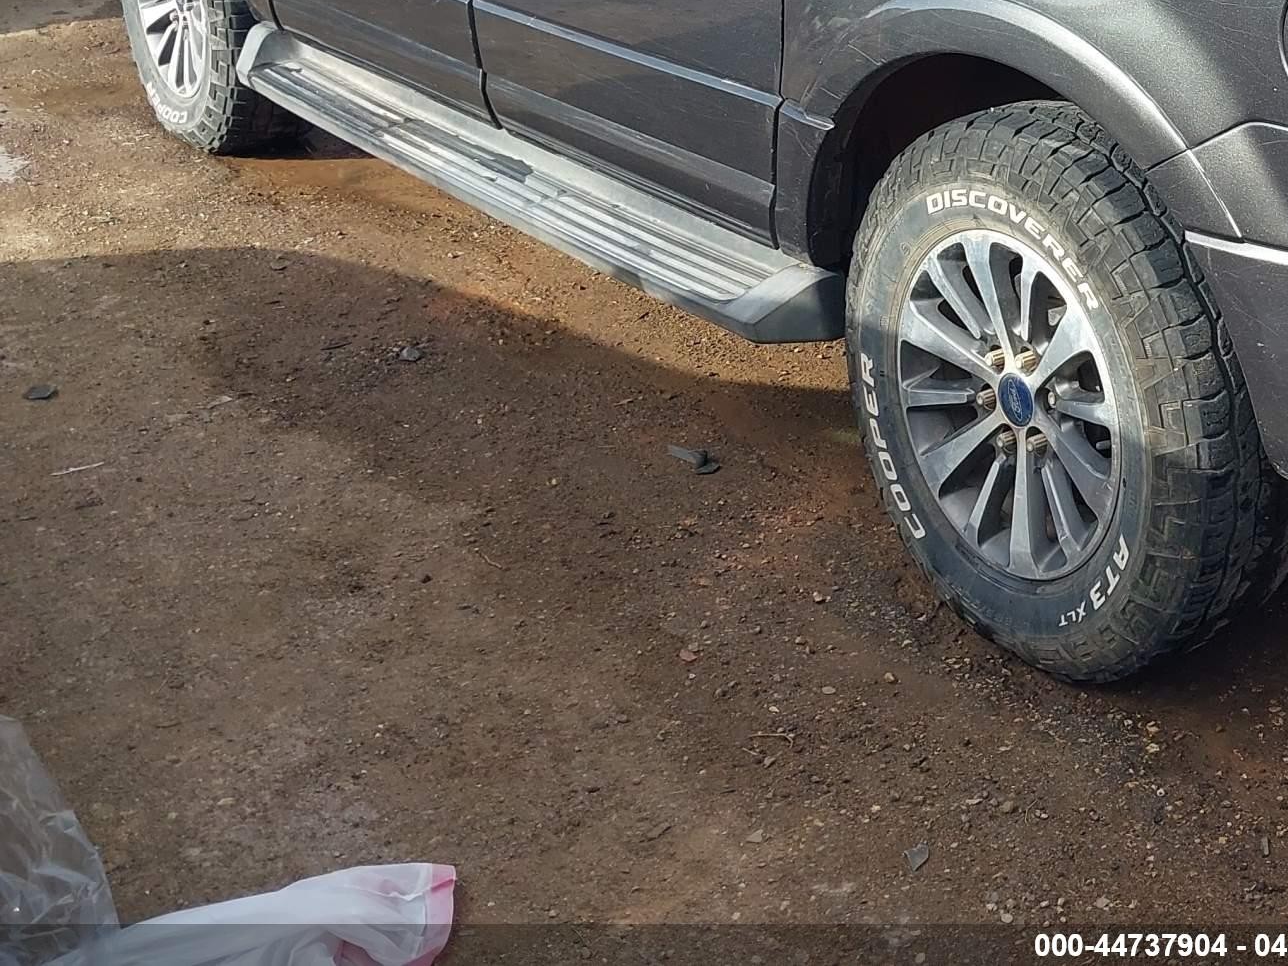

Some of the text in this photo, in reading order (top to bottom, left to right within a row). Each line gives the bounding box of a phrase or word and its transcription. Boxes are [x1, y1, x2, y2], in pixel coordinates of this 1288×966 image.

[926, 188, 1100, 309] DISCOVERER
[860, 352, 926, 540] COOPER
[1058, 533, 1130, 627] AT3 XLT
